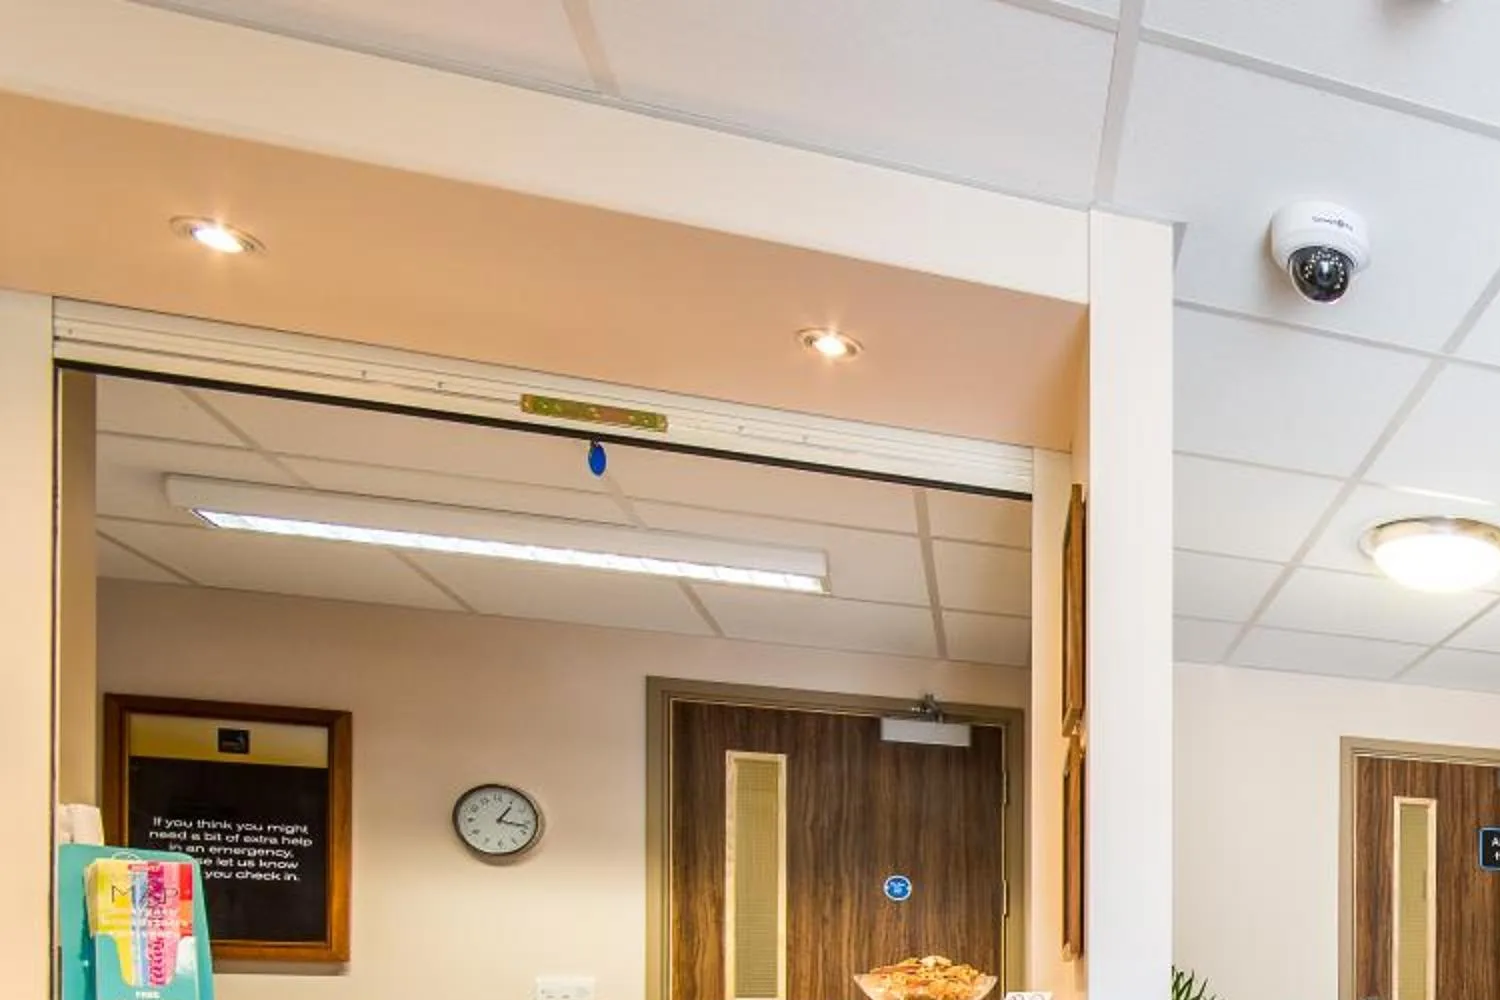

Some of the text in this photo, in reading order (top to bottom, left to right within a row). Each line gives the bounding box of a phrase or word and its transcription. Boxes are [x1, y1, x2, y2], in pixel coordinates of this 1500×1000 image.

[153, 816, 308, 835] If you think you might
[149, 830, 187, 840] need
[204, 831, 222, 841] bit
[226, 833, 239, 843] of
[243, 835, 278, 845] extra
[281, 835, 313, 847] help
[169, 843, 295, 858] in an emergency,
[215, 857, 234, 867] let
[237, 859, 255, 867] us
[258, 857, 299, 869] know
[204, 869, 300, 881] you check in.
